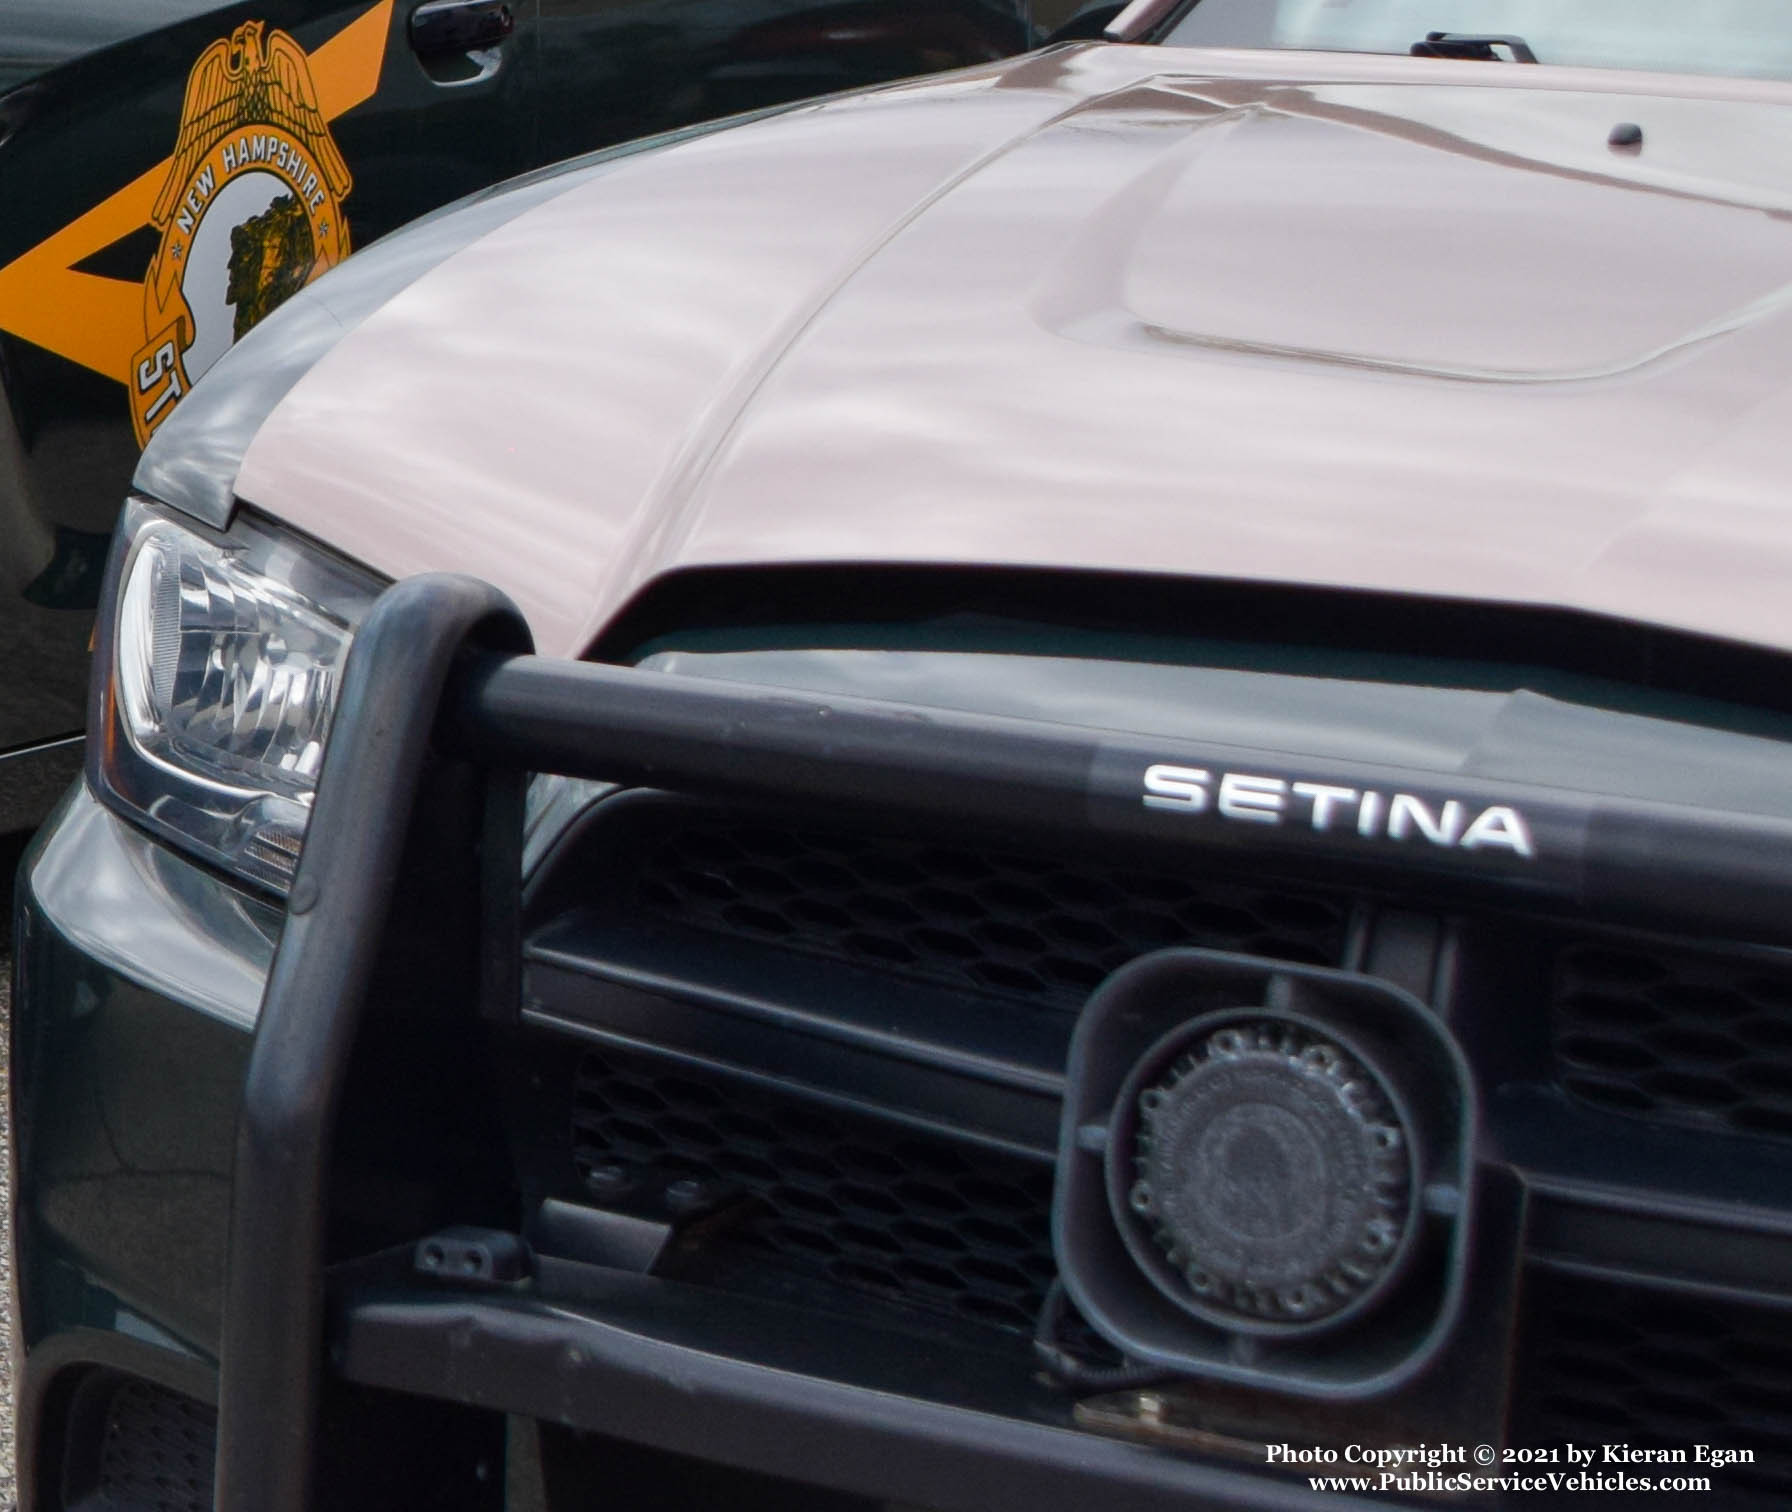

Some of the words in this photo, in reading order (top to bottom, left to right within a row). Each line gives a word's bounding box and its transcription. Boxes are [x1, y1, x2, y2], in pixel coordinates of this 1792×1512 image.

[176, 164, 215, 234] NEW
[222, 136, 325, 215] HAMPSHIRE
[1143, 764, 1535, 858] SETINA
